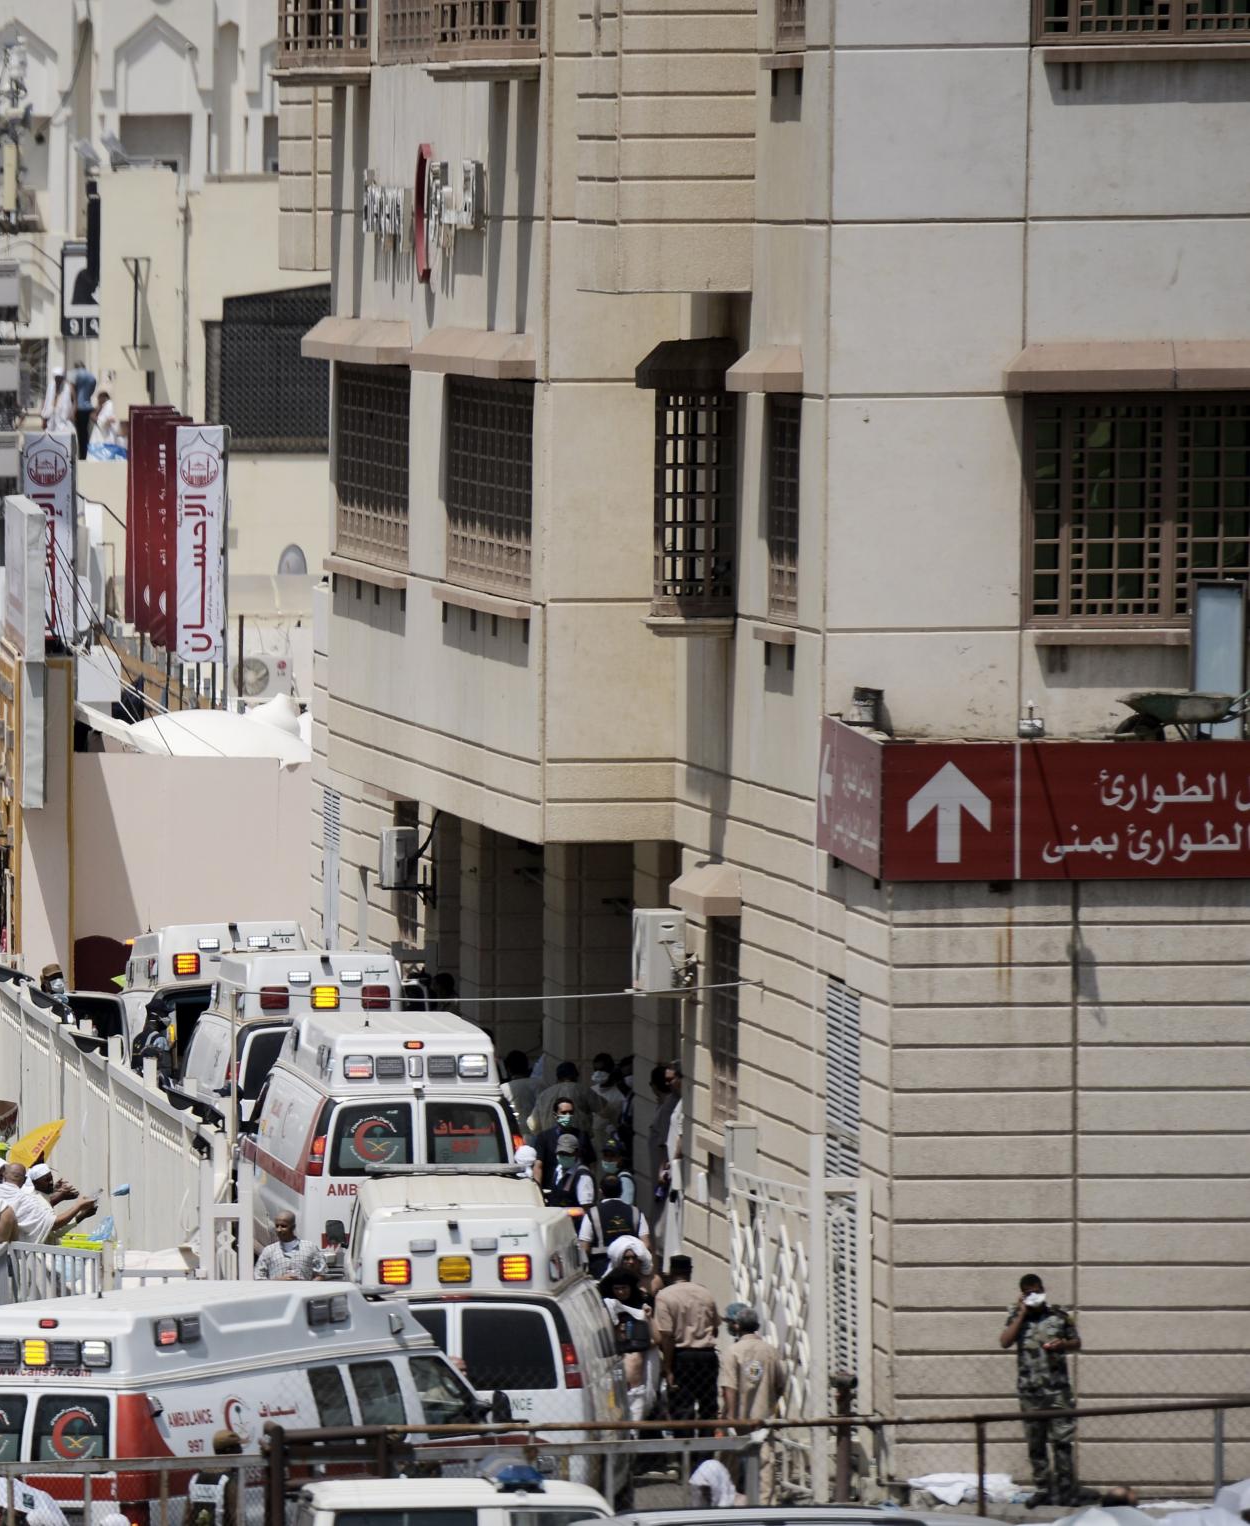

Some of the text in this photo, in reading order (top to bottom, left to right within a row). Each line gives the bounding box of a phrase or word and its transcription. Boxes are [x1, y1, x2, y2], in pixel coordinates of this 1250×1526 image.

[1099, 769, 1227, 814] الطوارئ
[1042, 823, 1120, 864] بمنى
[167, 1408, 214, 1427] AMBULANCE
